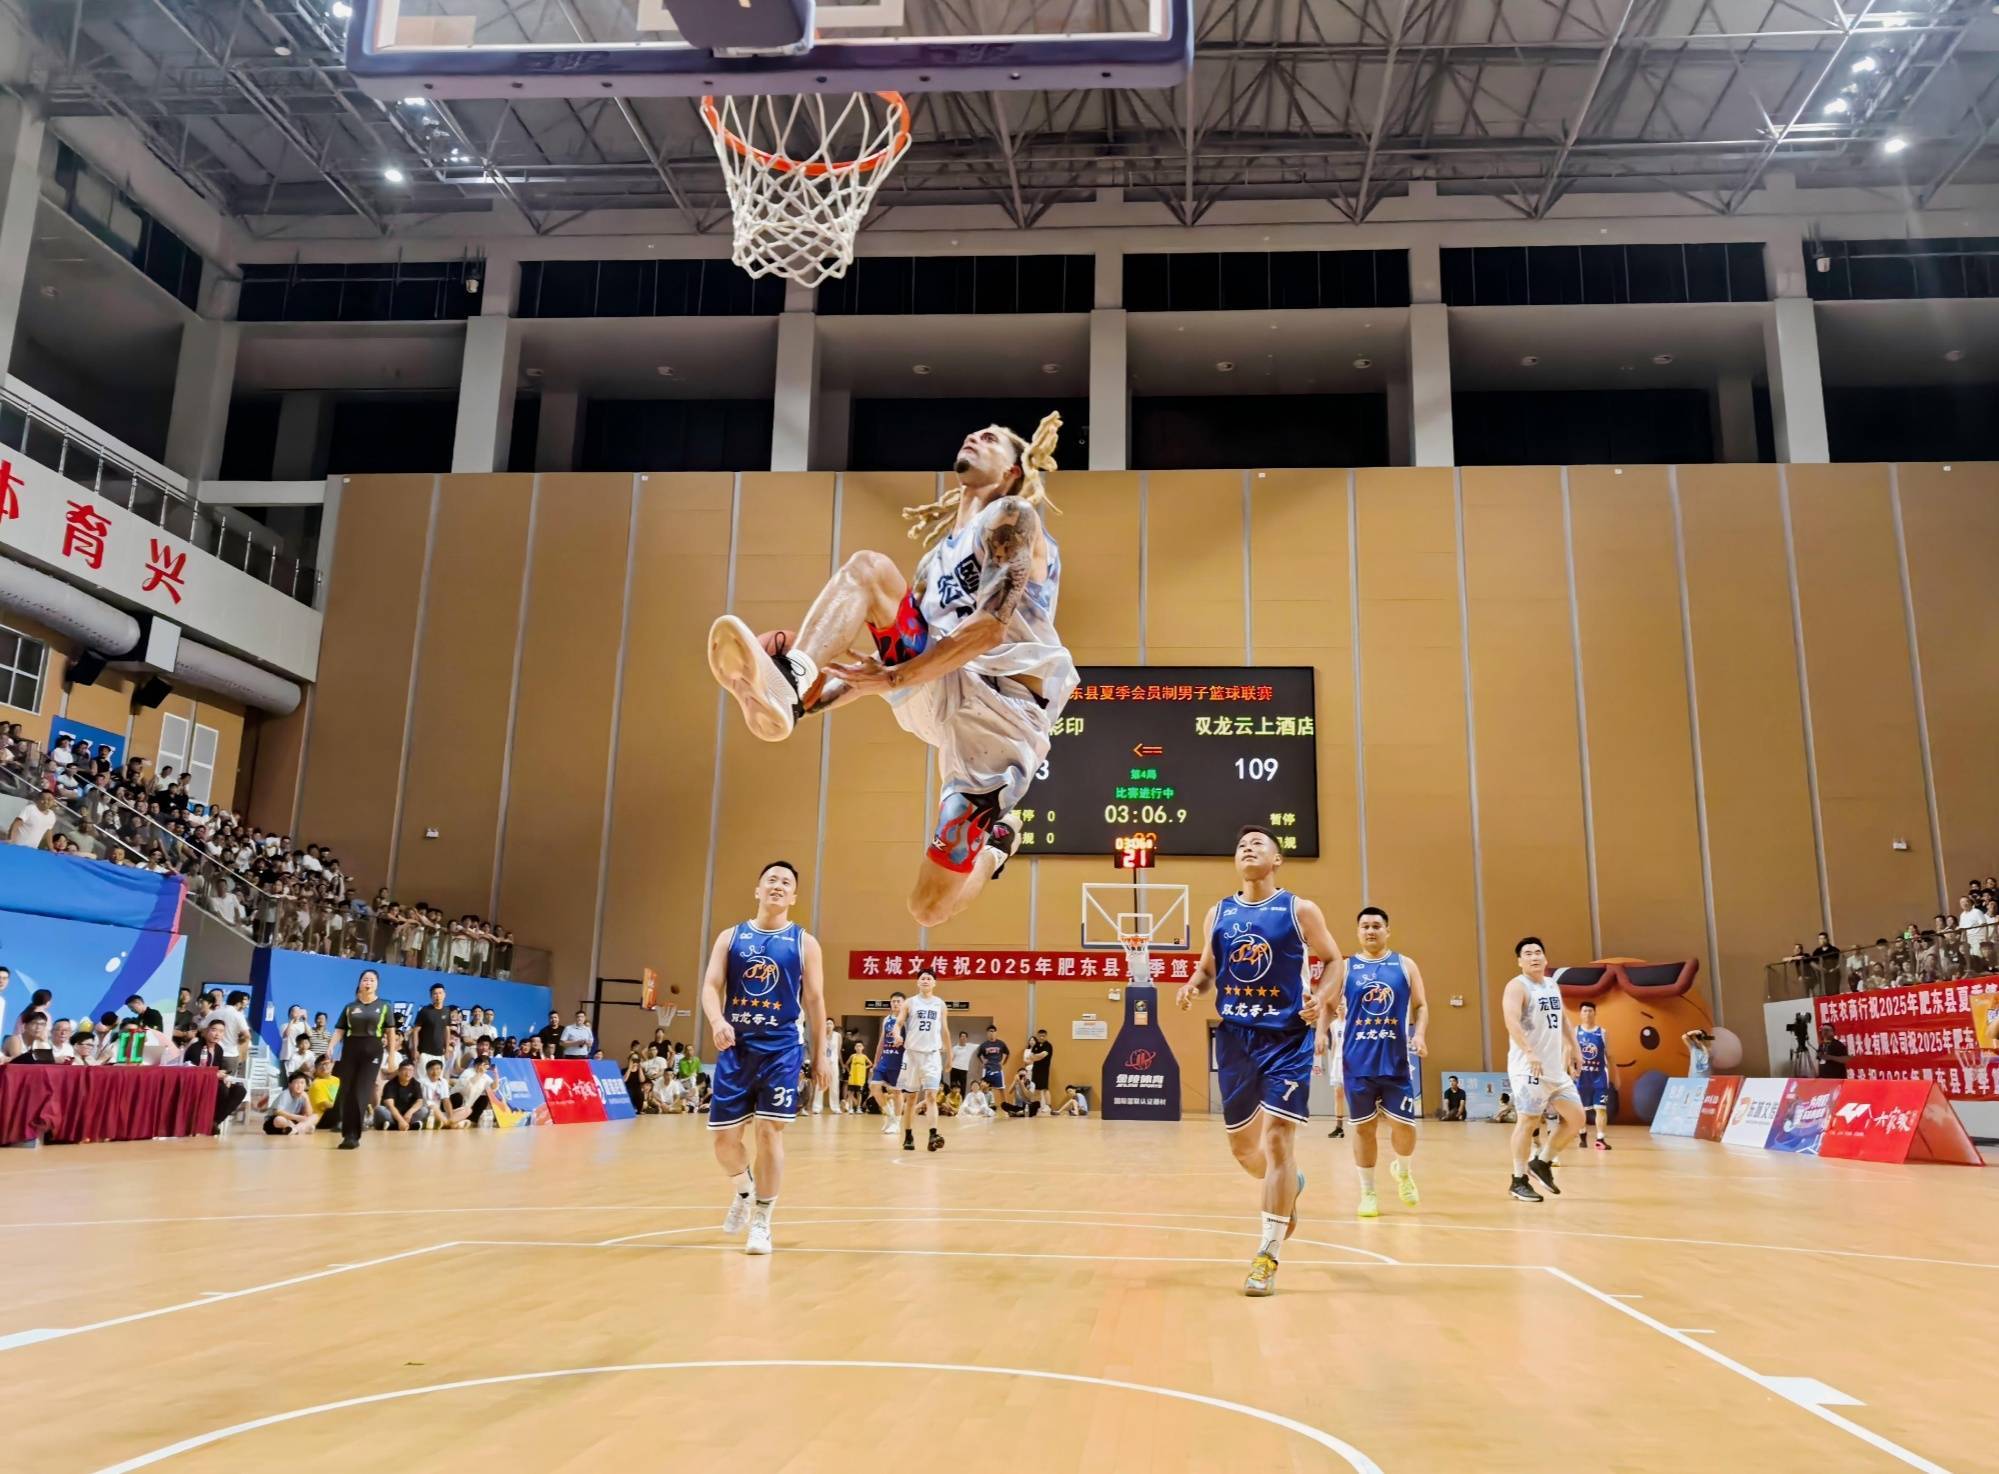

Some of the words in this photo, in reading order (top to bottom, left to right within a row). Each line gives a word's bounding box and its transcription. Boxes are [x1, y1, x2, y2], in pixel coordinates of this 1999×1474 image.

[1195, 716, 1314, 736] 双龙云上酒店
[1235, 758, 1279, 782] 109
[1115, 787, 1175, 799] 比赛进行中
[1047, 810, 1056, 822] 0
[1104, 805, 1187, 823] 03:06.9
[1270, 813, 1296, 826] 暂停
[1046, 832, 1055, 844] 0
[919, 1021, 931, 1031] 23
[1547, 1013, 1558, 1029] 13
[771, 1086, 795, 1107] 35
[1282, 1079, 1299, 1101] 7
